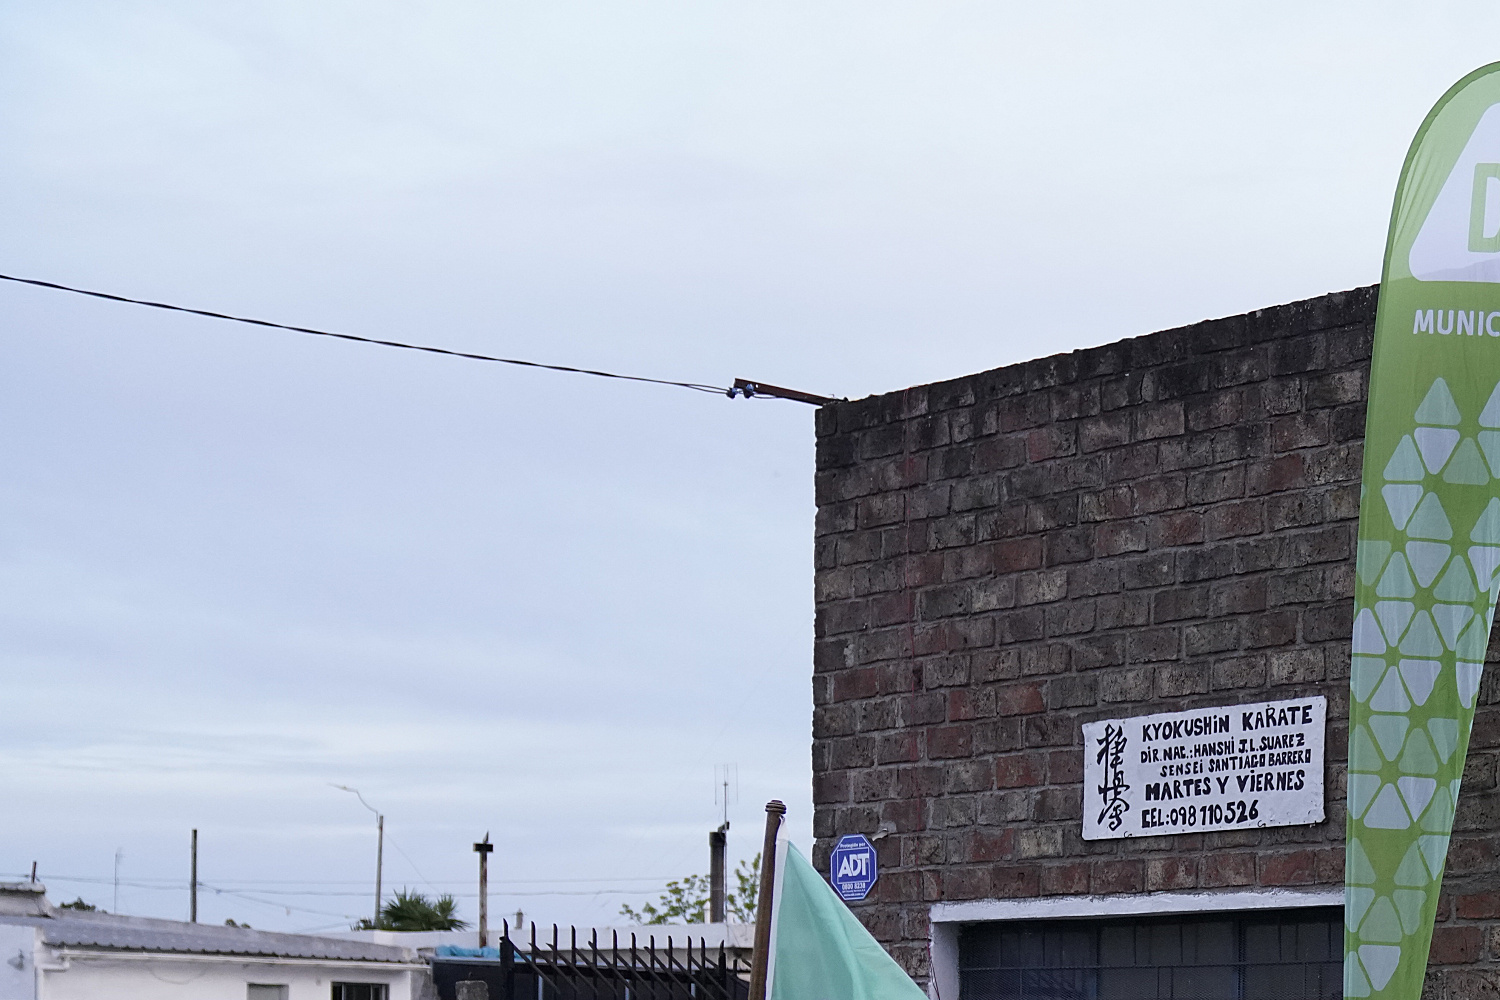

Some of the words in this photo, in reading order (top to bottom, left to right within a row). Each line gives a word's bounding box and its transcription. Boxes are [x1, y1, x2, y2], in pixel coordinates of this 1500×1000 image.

[1142, 714, 1230, 743] KYOKUSHiN
[1242, 704, 1313, 731] KARATE
[1160, 759, 1203, 778] SENSEi
[1208, 754, 1266, 773] SANTIAGO
[1268, 748, 1312, 767] BARRERO
[1145, 777, 1211, 801] MARTES
[1216, 776, 1230, 794] Y
[1236, 769, 1305, 793] ViERNES
[838, 853, 870, 878] ADT
